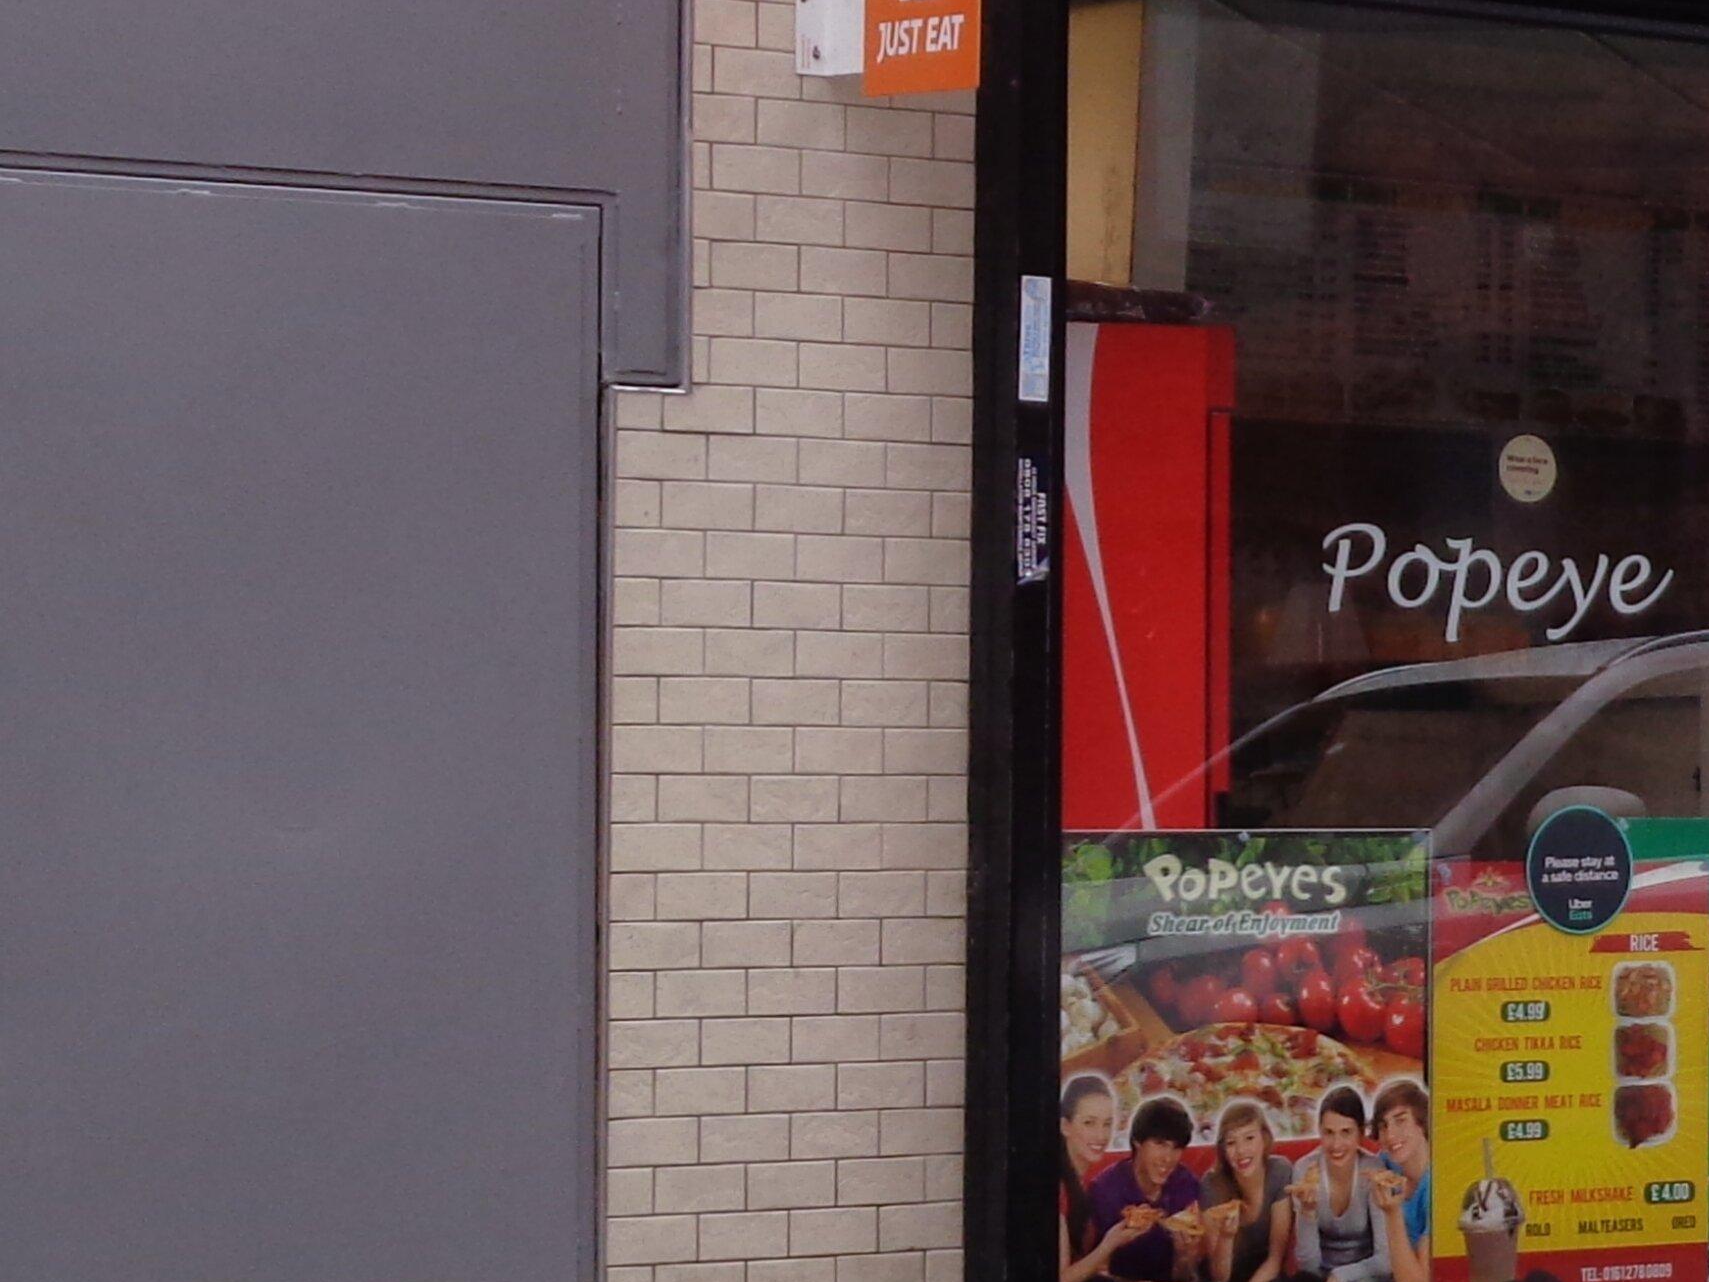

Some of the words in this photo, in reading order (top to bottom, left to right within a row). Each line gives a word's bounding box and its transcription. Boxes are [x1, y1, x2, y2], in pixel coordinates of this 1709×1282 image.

[877, 16, 920, 62] JUST
[924, 14, 964, 53] EAT
[1321, 522, 1675, 642] Popeye
[1545, 856, 1580, 869] Please
[1580, 856, 1602, 870] stay
[1604, 855, 1616, 867] at
[1550, 870, 1573, 883] safe
[1574, 869, 1620, 883] distance
[1149, 911, 1208, 935] Shear
[1212, 912, 1234, 935] of
[1237, 909, 1342, 937] Enjoyment
[1629, 934, 1659, 952] RICE
[1450, 977, 1482, 992] PLAIN
[1486, 976, 1528, 992] GRILLED
[1532, 975, 1576, 991] CHICKEN
[1580, 975, 1603, 990] RICE
[1507, 1001, 1545, 1021] £4.99
[1474, 1036, 1519, 1052] CHICKEN
[1524, 1035, 1555, 1051] TIKKA
[1559, 1035, 1582, 1050] RICE
[1506, 1063, 1543, 1081] £5.99
[1447, 1097, 1492, 1113] MASALA
[1544, 1094, 1574, 1109] MEAT
[1579, 1093, 1602, 1108] RICE
[1507, 1121, 1543, 1140] £4.99
[1529, 1190, 1565, 1206] FRESH
[1571, 1186, 1633, 1203] MILKSHAKE
[1578, 1218, 1644, 1235] MALTEASERS
